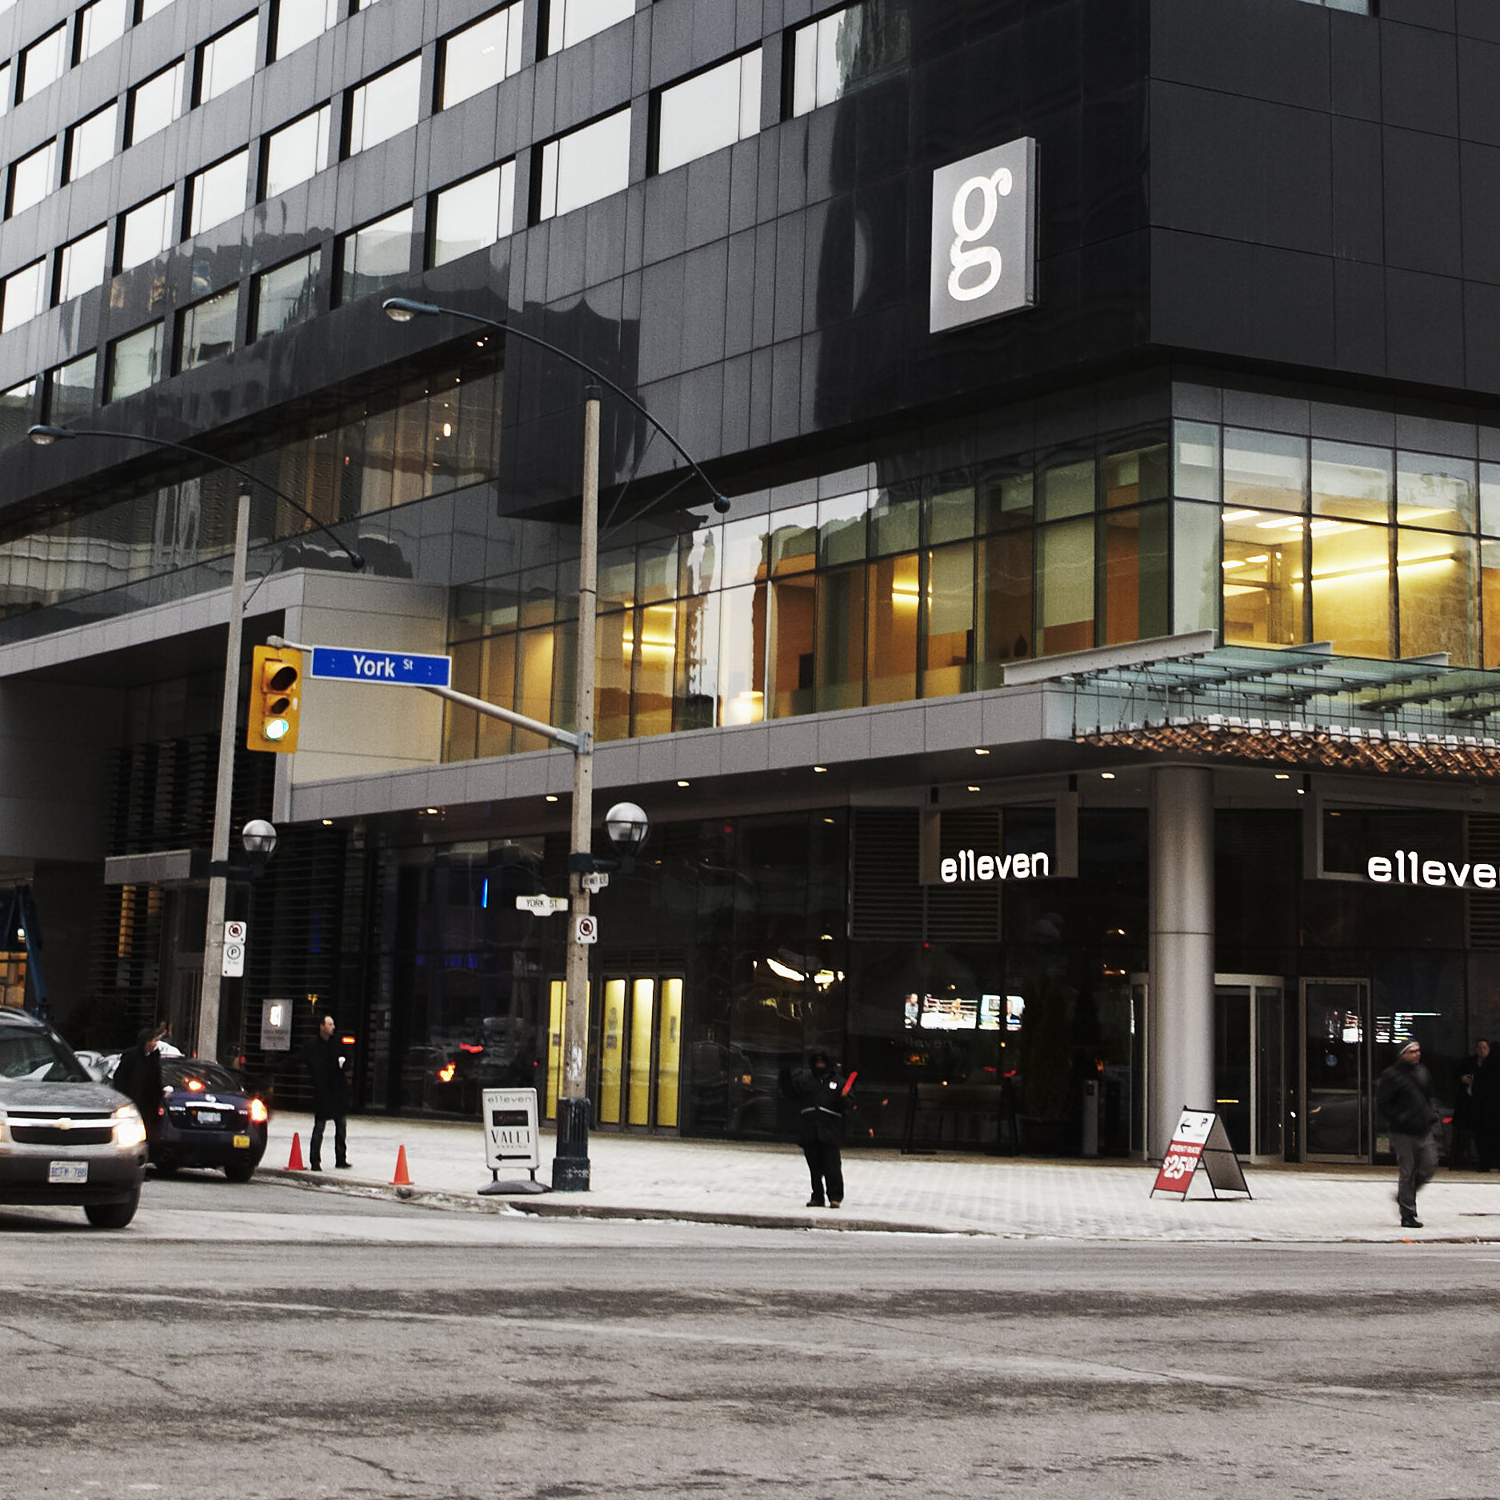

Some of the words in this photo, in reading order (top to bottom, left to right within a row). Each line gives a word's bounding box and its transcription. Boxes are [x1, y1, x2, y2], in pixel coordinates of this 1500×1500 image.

[948, 167, 1012, 301] g
[352, 654, 396, 678] York
[403, 659, 414, 670] St
[526, 898, 544, 908] YORK
[549, 900, 558, 908] ST
[491, 1130, 531, 1144] VALET
